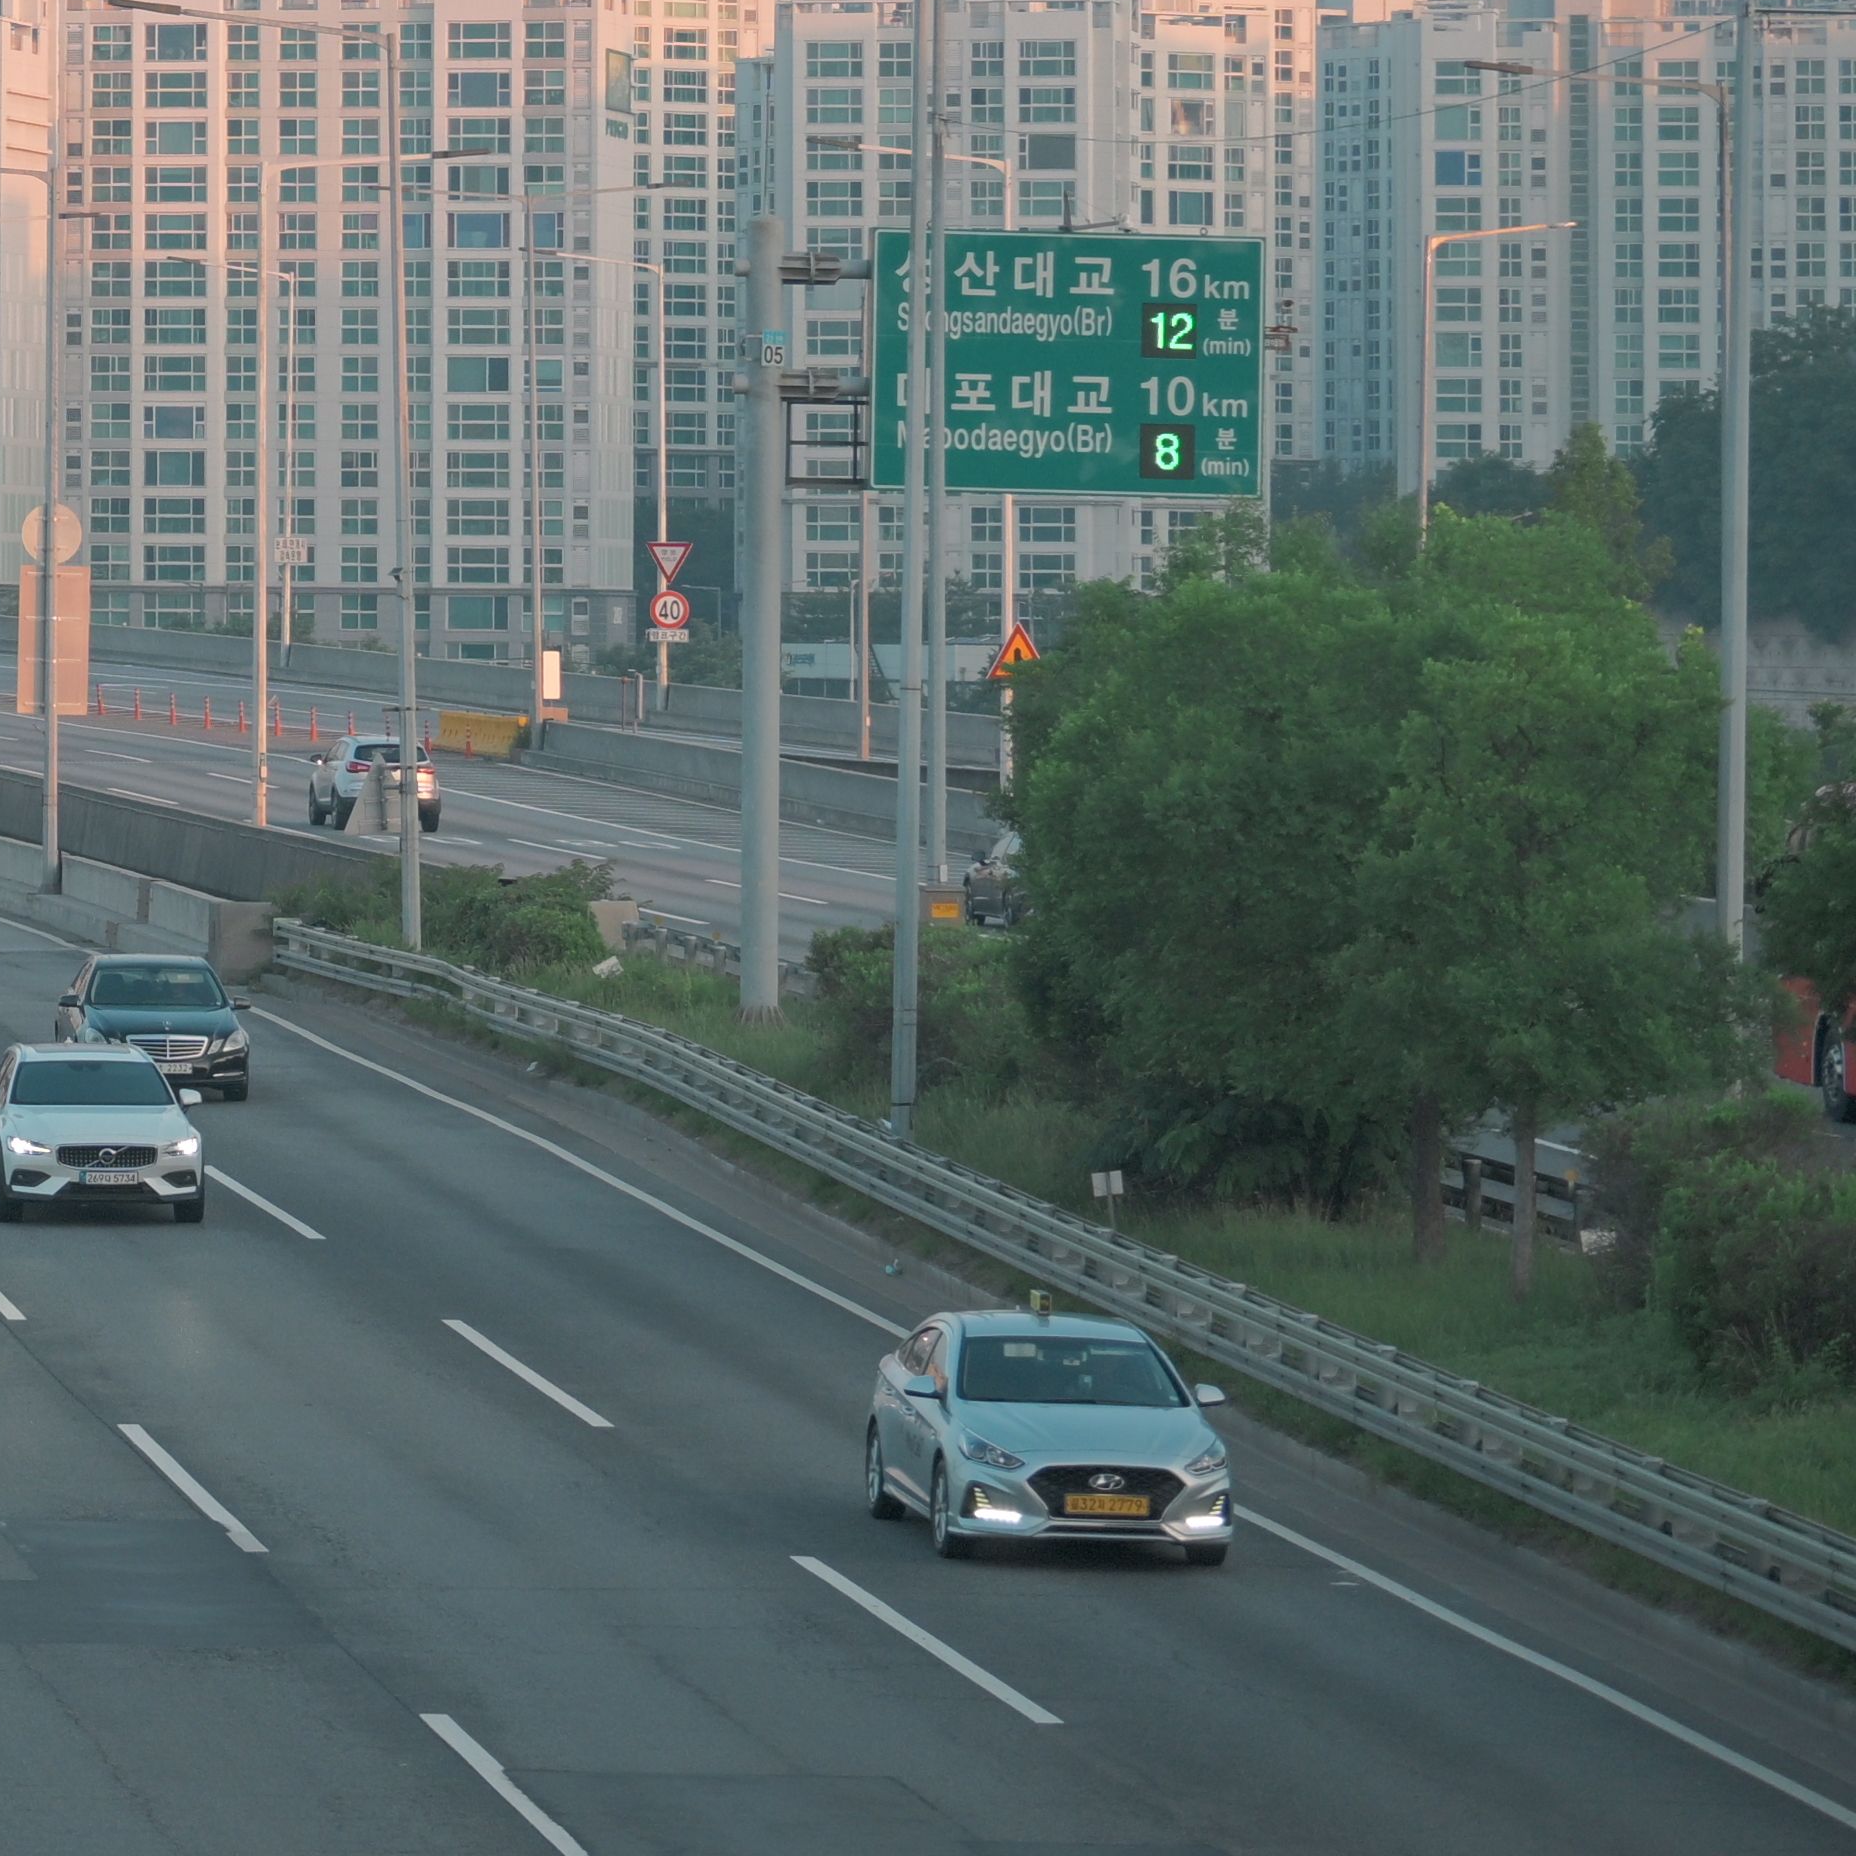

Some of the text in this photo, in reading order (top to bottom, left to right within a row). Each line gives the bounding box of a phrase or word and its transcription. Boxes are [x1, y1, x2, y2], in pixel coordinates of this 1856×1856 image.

[1142, 258, 1197, 298] 16
[1204, 274, 1250, 299] km
[1217, 308, 1239, 330] 분
[1150, 312, 1193, 350] 12
[764, 345, 783, 364] 05
[1203, 337, 1251, 357] (min)
[1140, 376, 1195, 416] 10
[1202, 392, 1248, 418] km
[1216, 428, 1238, 450] 분
[1155, 433, 1180, 471] 8
[1201, 457, 1250, 477] (min)
[659, 600, 681, 620] 40
[1109, 1498, 1143, 1512] 2779
